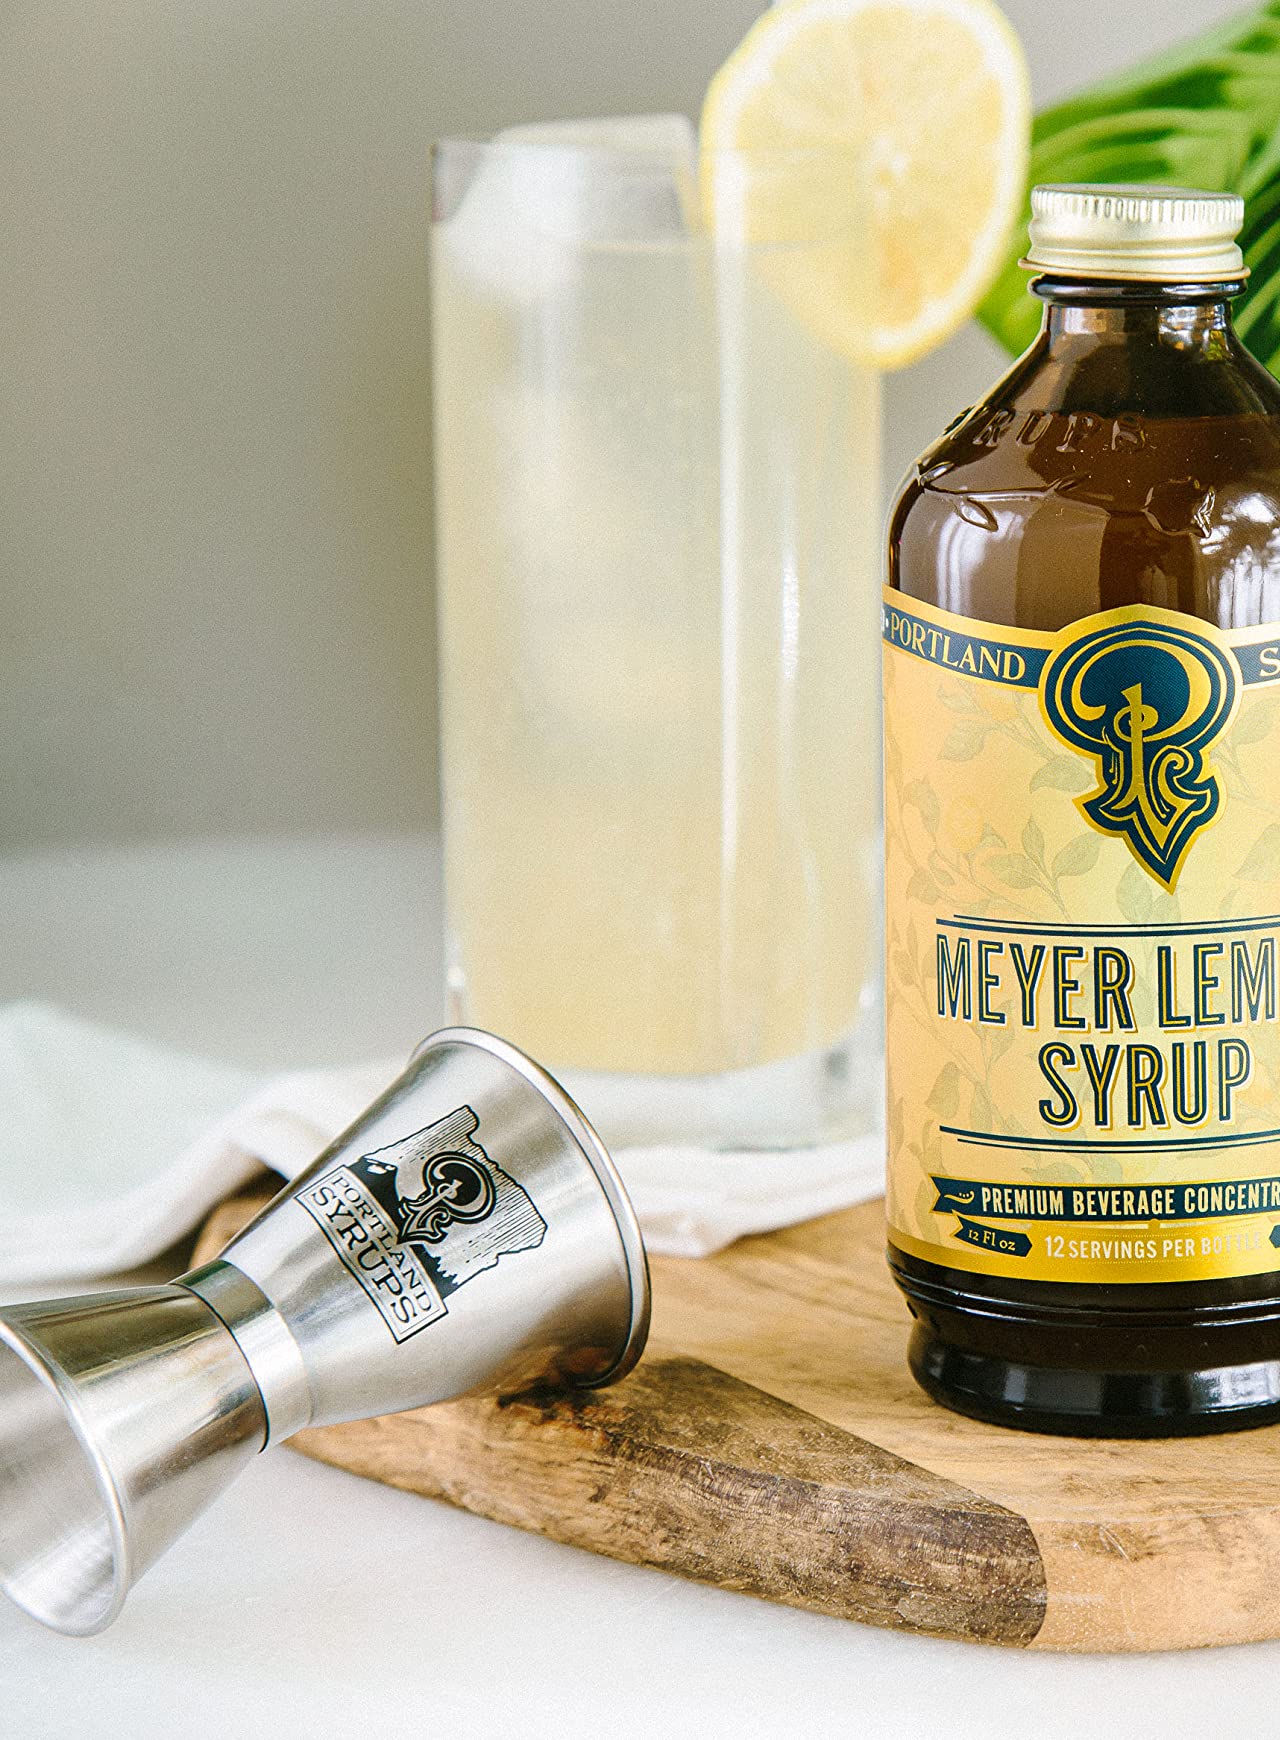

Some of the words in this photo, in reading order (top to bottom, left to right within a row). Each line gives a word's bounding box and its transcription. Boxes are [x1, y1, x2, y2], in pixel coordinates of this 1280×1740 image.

[890, 611, 1028, 682] PORTLAND
[936, 933, 1136, 1031] MEYER
[1038, 1038, 1252, 1128] SYRUP
[968, 1228, 980, 1242] 12
[982, 1230, 996, 1248] Fl
[999, 1239, 1017, 1252] oz
[980, 1186, 1065, 1216] PREMIUM
[1072, 1187, 1176, 1216] BEVERAGE
[310, 1185, 419, 1325] SYRUPS
[330, 1175, 433, 1313] PORTLAND
[1044, 1235, 1066, 1259] 12
[1068, 1239, 1158, 1260] SERVINGS
[1163, 1238, 1196, 1259] PER
[1200, 1231, 1263, 1256] BOTTLE
